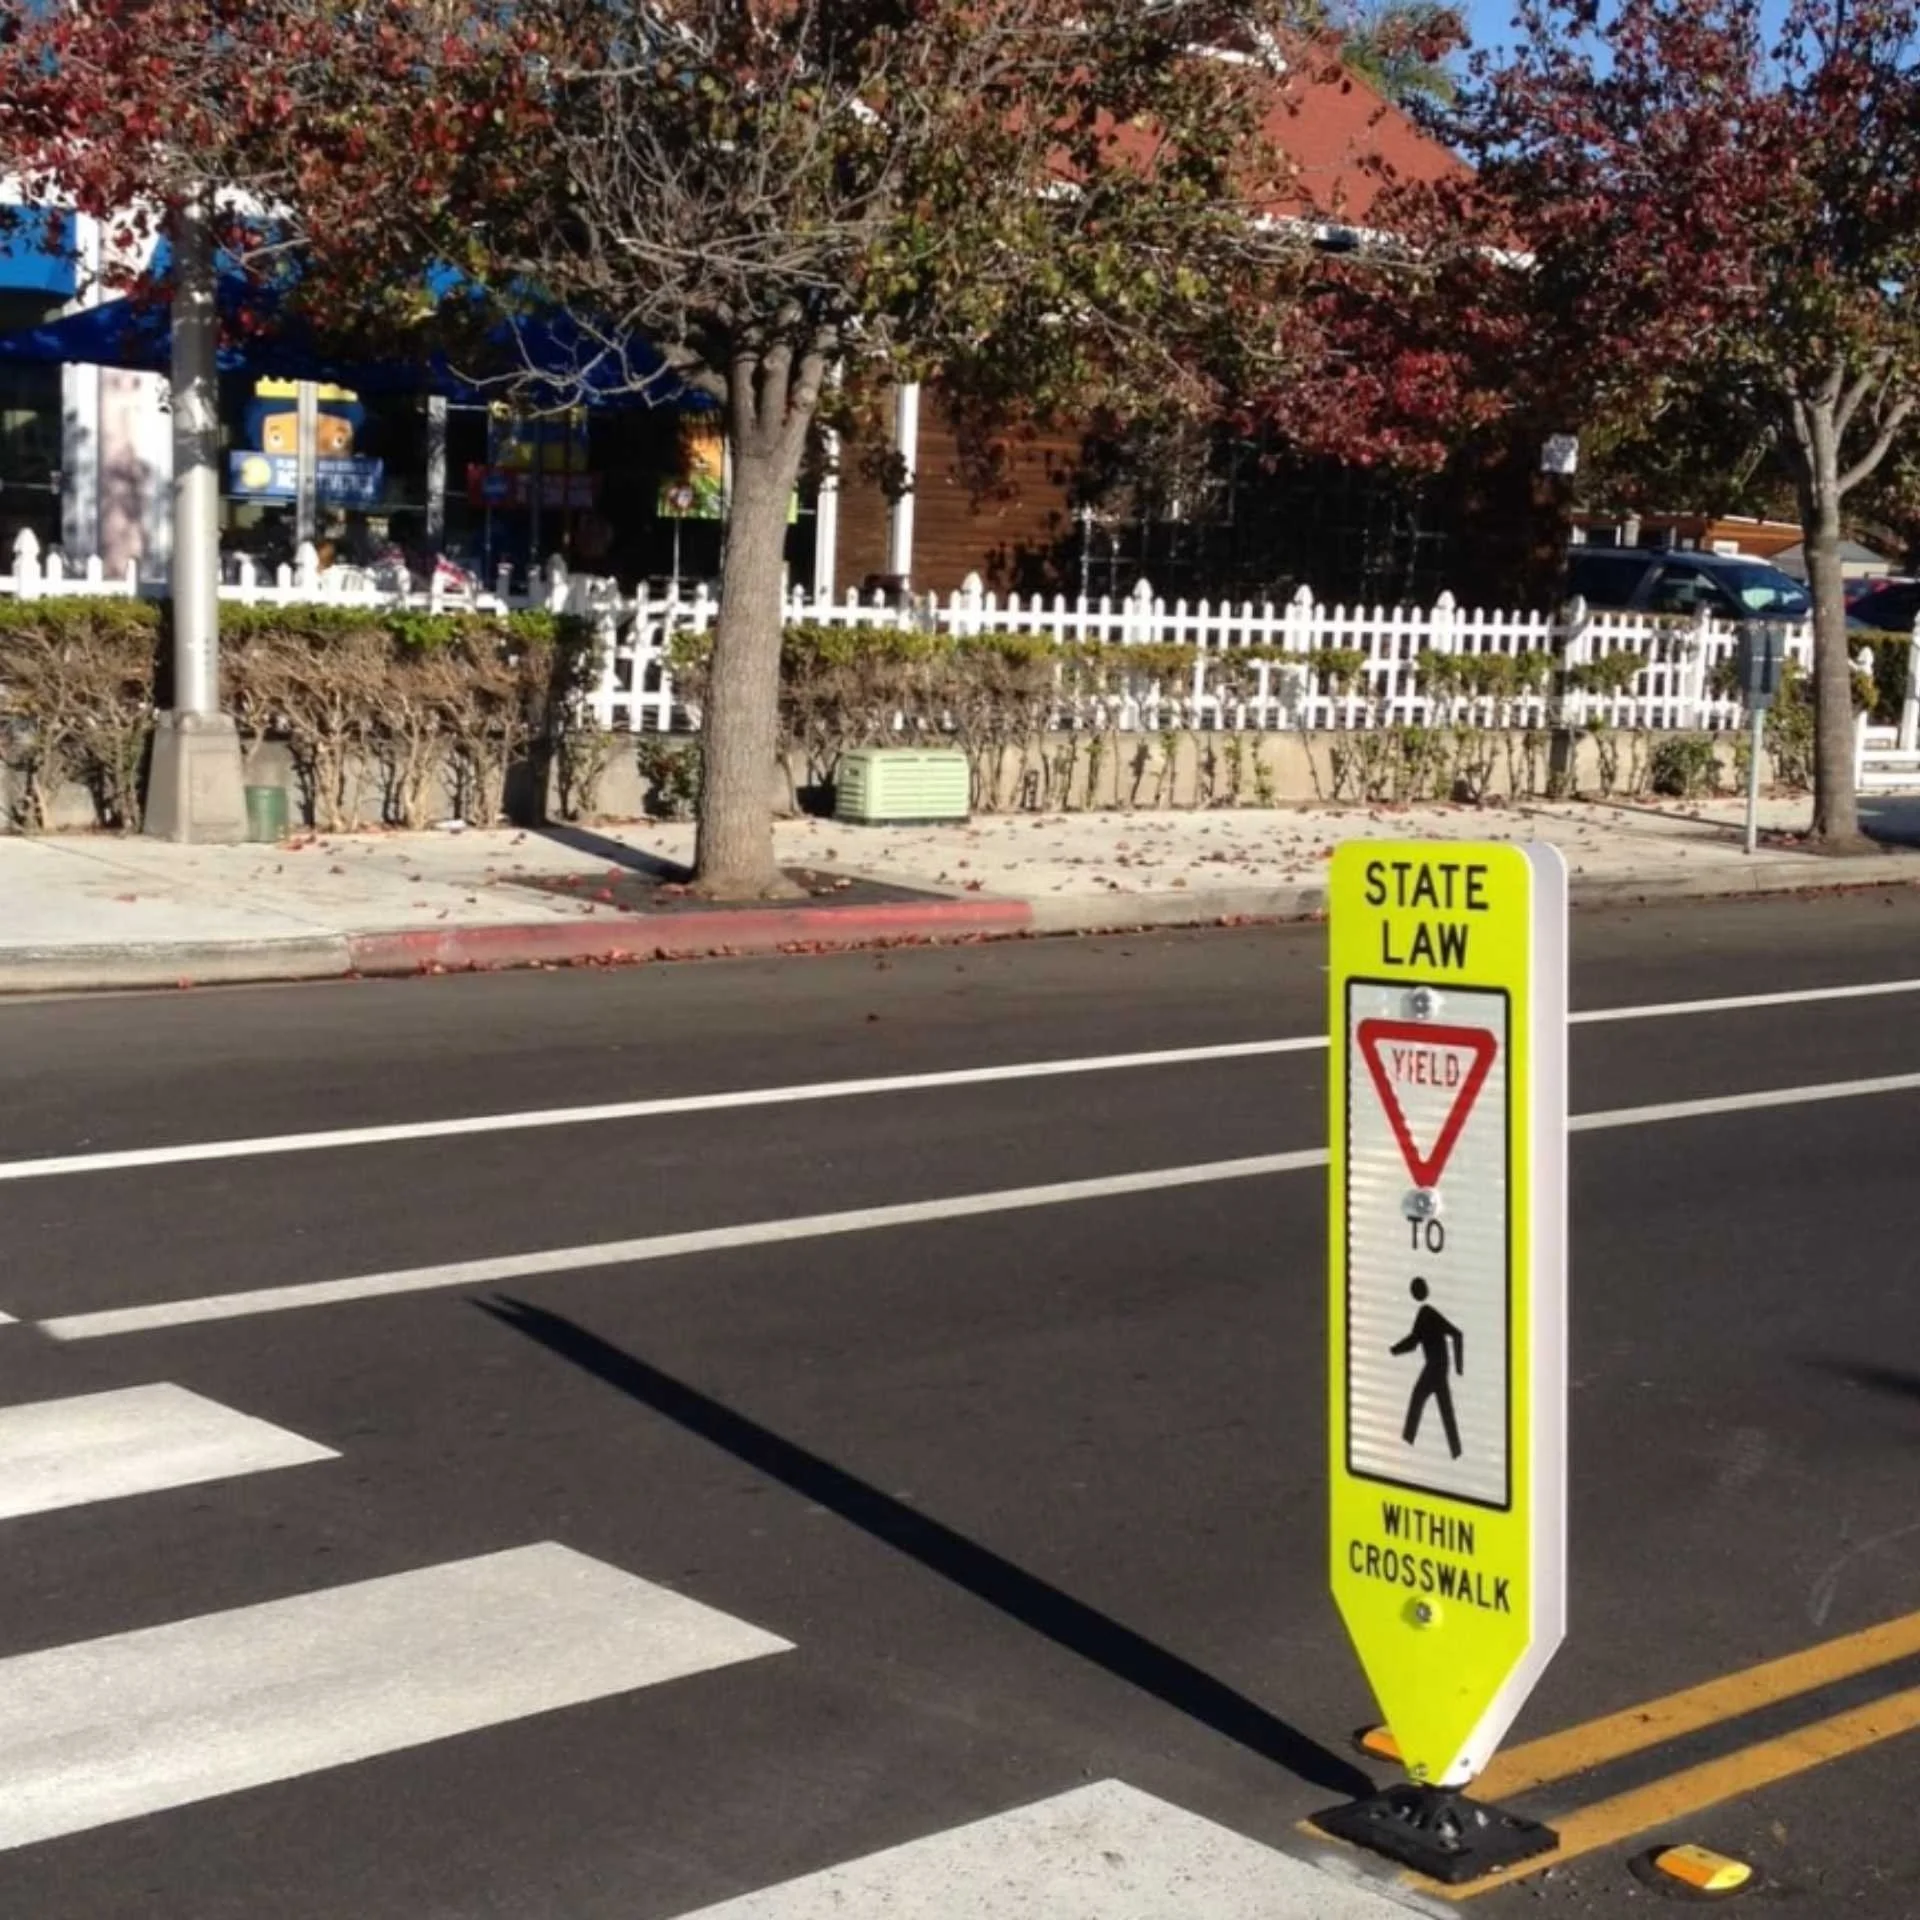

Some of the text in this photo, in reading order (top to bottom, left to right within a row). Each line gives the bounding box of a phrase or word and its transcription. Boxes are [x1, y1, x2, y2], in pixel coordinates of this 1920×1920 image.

[1365, 861, 1489, 910] STATE
[1382, 921, 1468, 968] LAW
[1391, 1048, 1459, 1087] YIELD
[1407, 1217, 1444, 1253] TO
[1382, 1503, 1474, 1555] WITHIN
[1349, 1541, 1510, 1613] CROSSWALK
